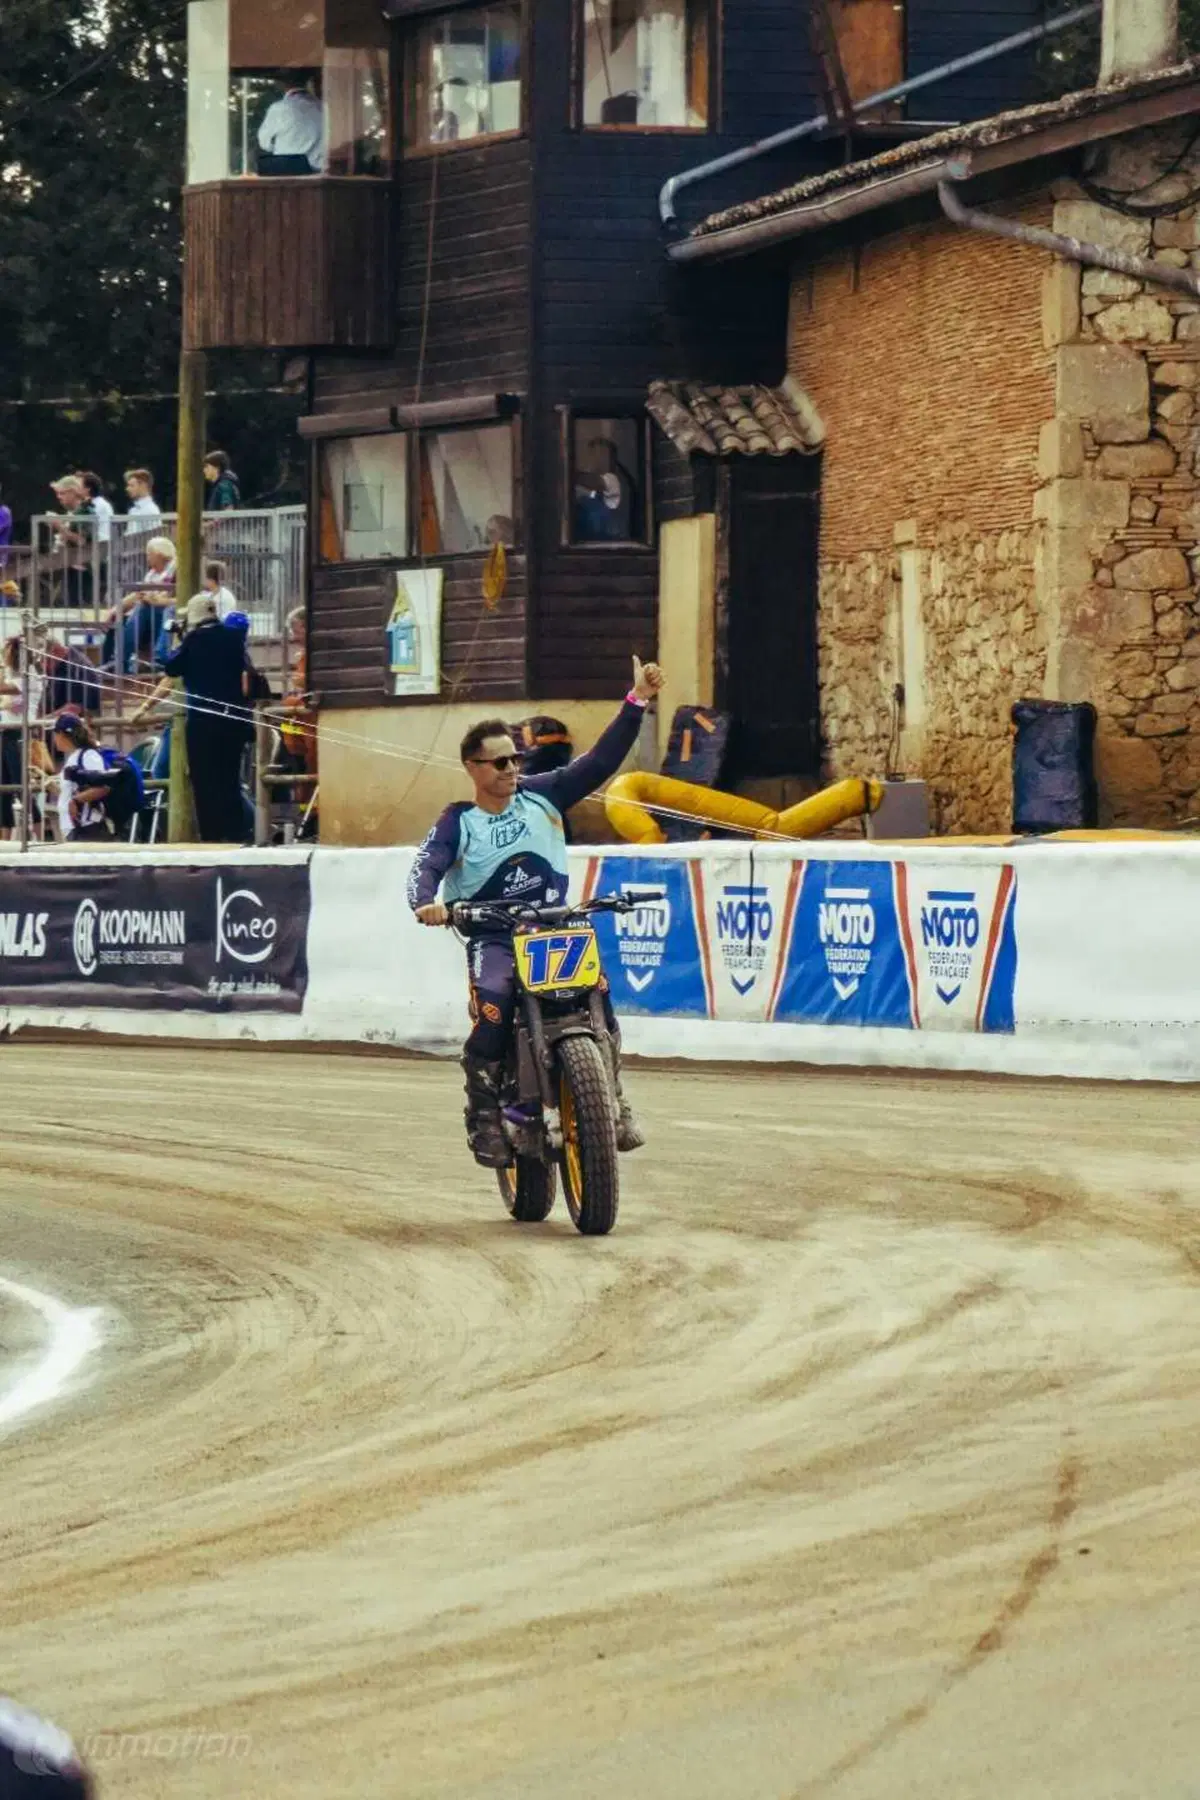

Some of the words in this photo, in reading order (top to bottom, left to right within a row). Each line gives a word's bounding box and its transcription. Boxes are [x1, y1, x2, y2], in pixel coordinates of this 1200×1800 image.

[99, 909, 186, 945] KOOPMANN
[614, 898, 670, 937] MOTO
[716, 901, 773, 941] MOTO
[818, 903, 875, 945] MOTO
[921, 906, 979, 948] MOTO
[524, 934, 593, 986] 17
